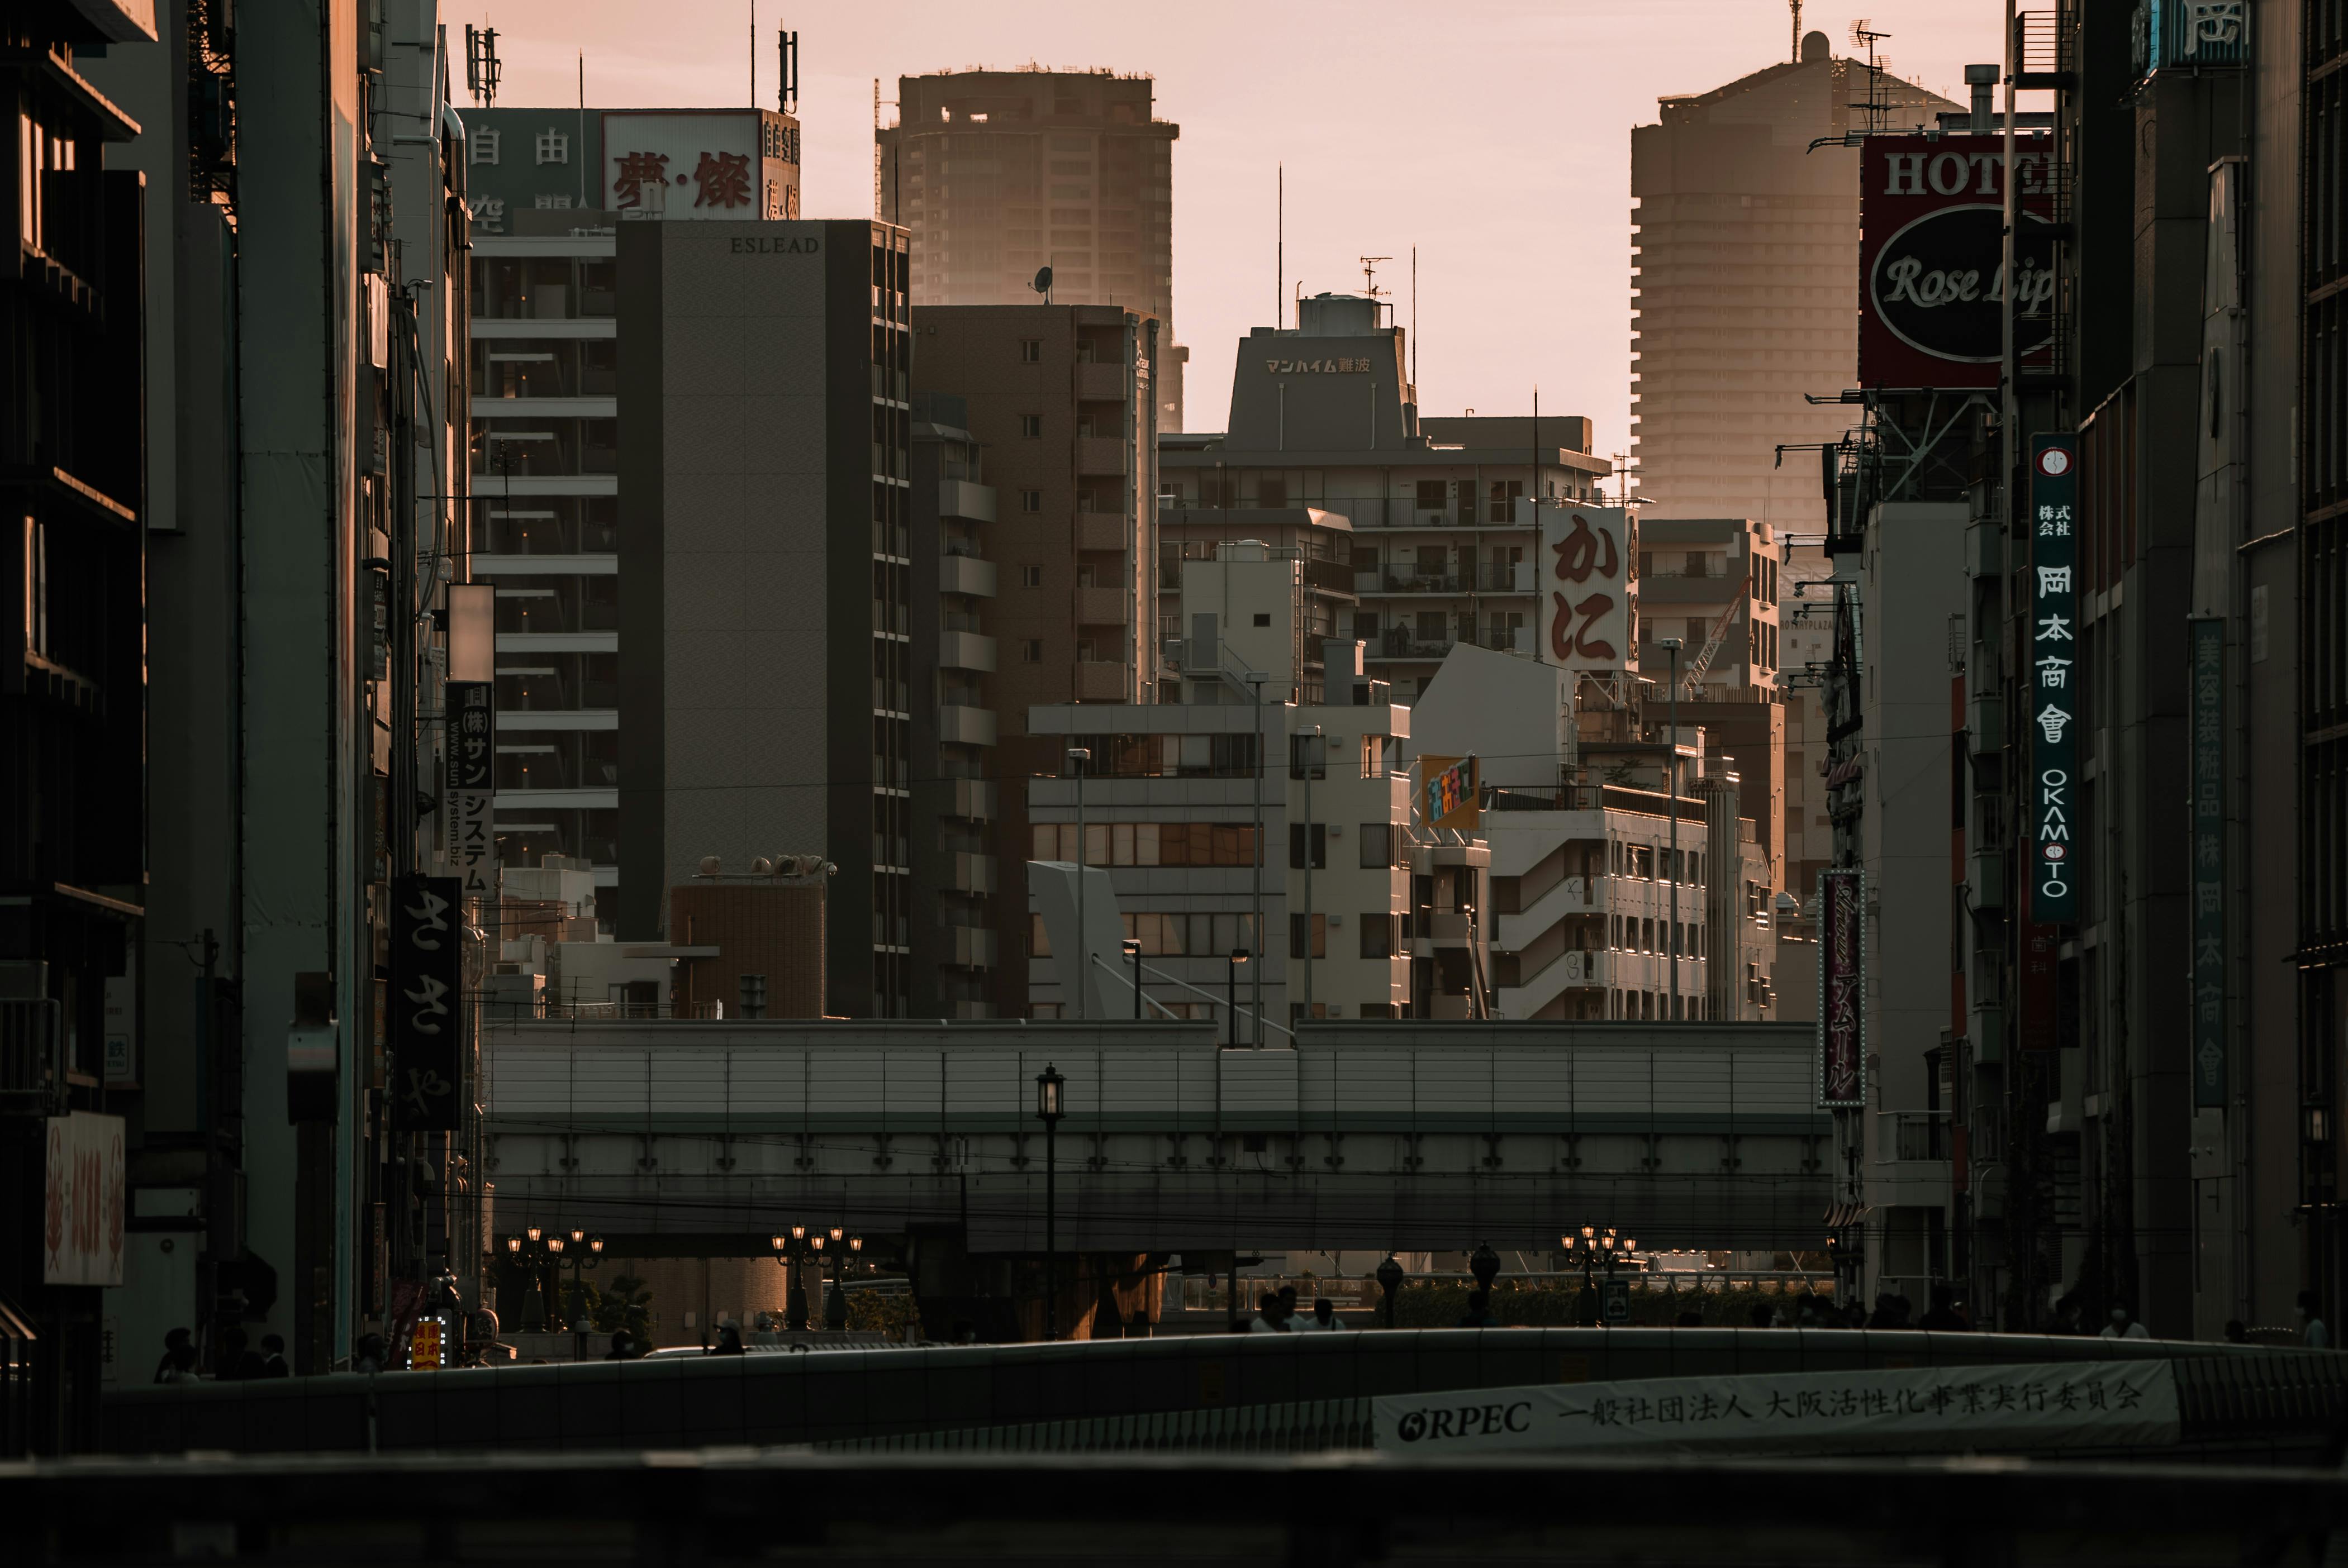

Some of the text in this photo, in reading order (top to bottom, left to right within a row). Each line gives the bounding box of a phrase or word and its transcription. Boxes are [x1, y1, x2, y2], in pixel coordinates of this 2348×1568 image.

[470, 124, 569, 165] 自由
[730, 237, 819, 254] ESLEAD
[1883, 255, 1980, 308] Rose
[1266, 358, 1371, 373] マンハイム難波
[1552, 514, 1618, 660] かに
[2029, 924, 2047, 974] 歯科
[1826, 974, 1860, 1092] アムール
[1558, 1379, 2143, 1427] 一般社団法人 大阪活性化事業実行委員会
